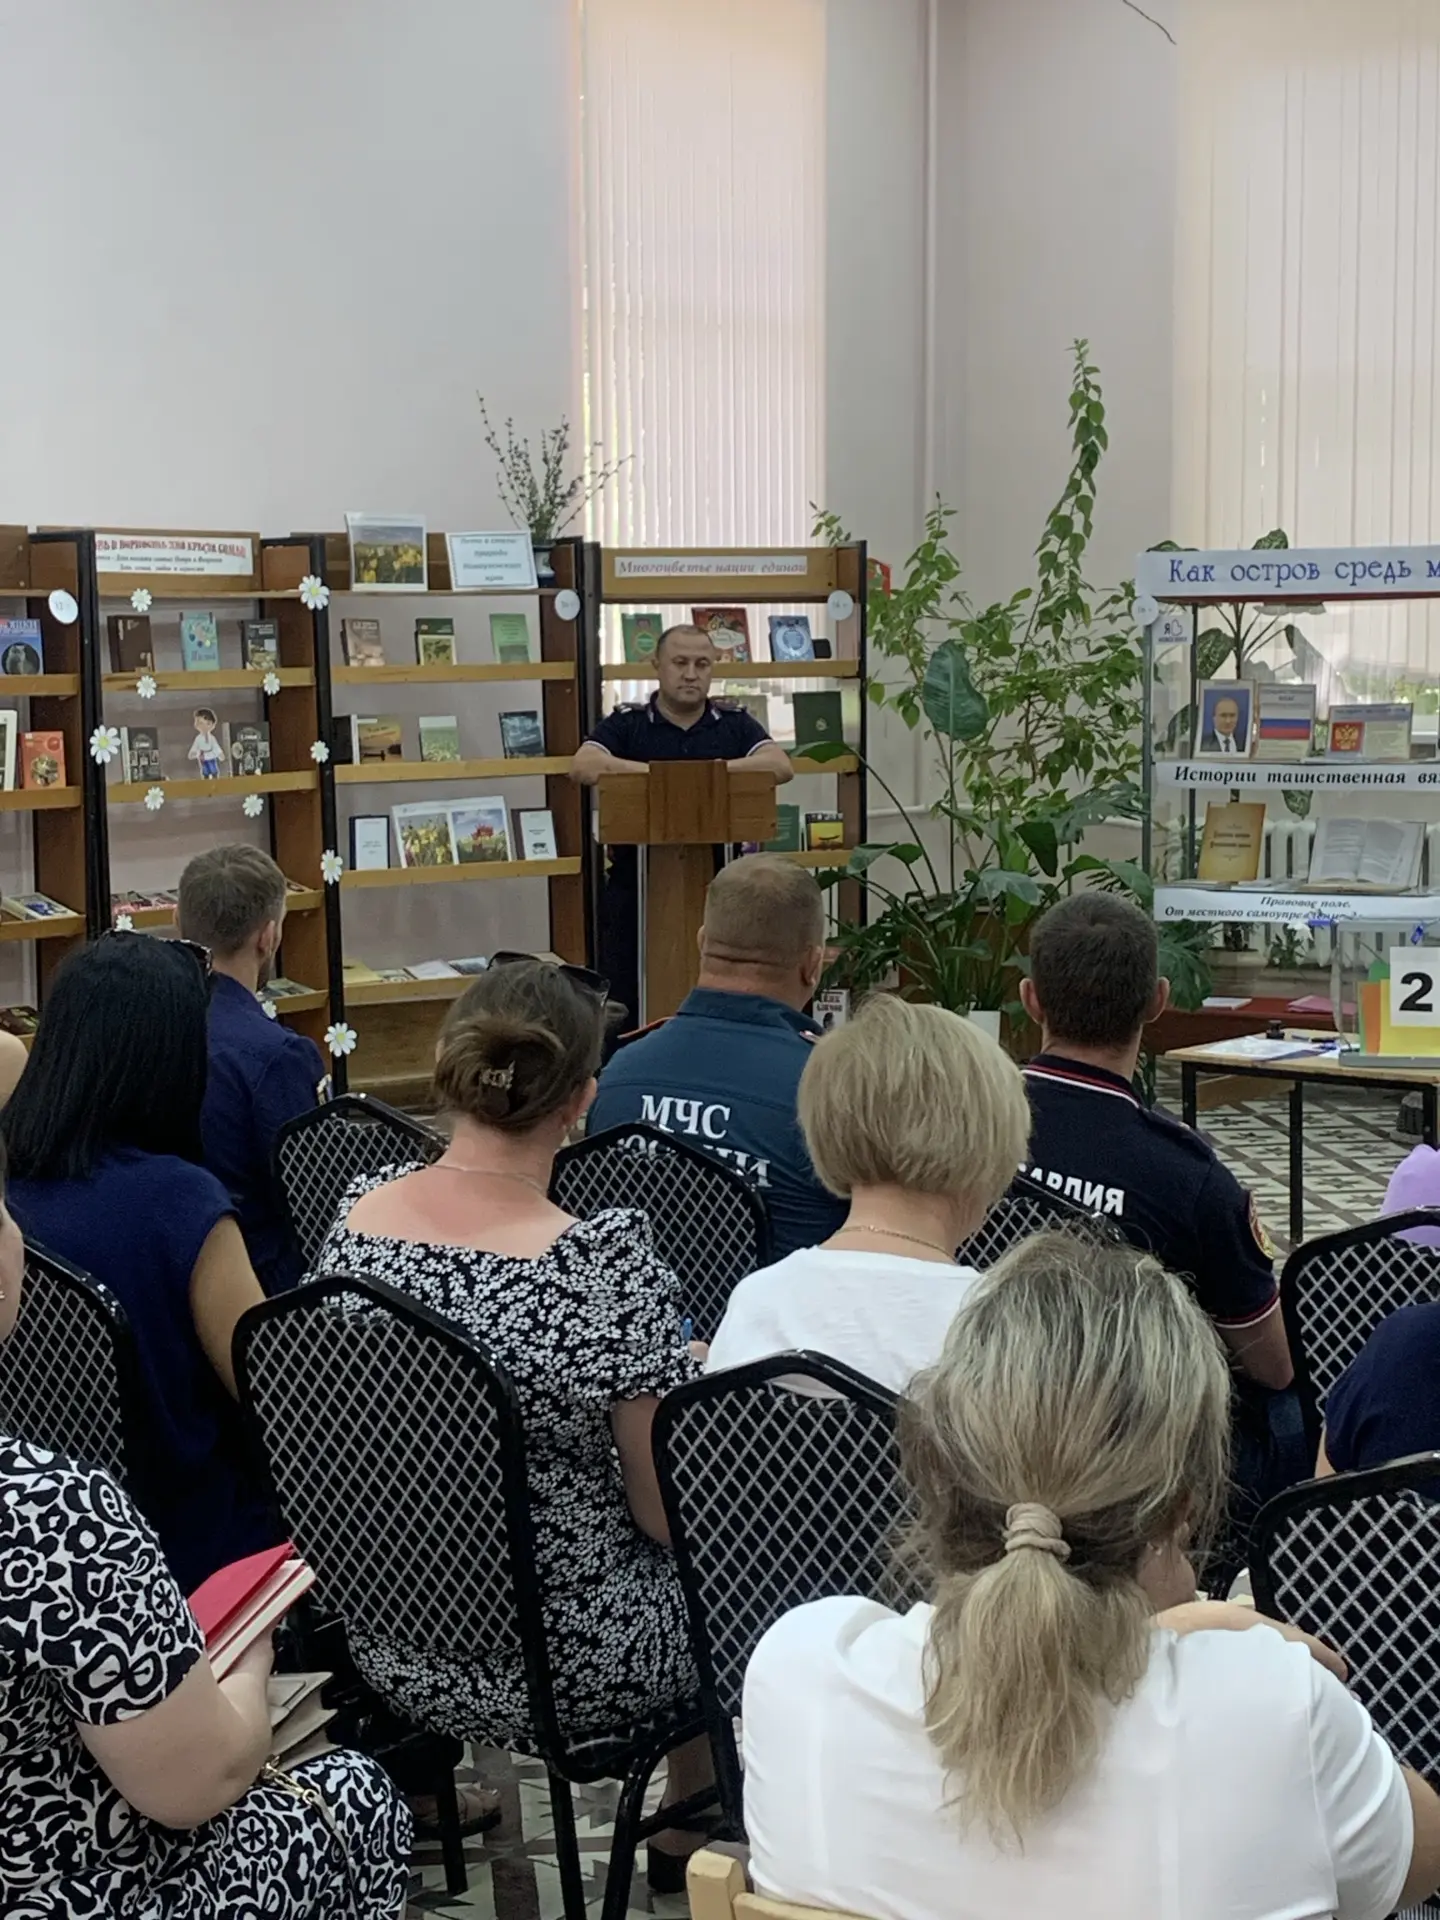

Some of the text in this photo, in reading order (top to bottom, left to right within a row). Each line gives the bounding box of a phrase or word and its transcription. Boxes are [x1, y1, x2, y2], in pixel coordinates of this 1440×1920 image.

[1168, 559, 1216, 583] Как
[1230, 560, 1321, 588] остров
[1335, 559, 1412, 586] средь
[1164, 623, 1171, 636] Я
[1174, 765, 1257, 785] Истории
[1267, 771, 1406, 784] таинственная
[1165, 906, 1185, 918] От
[1187, 908, 1245, 918] местного
[1260, 896, 1318, 909] Правовое
[1398, 972, 1433, 1012] 2
[641, 1095, 731, 1140] МЧС
